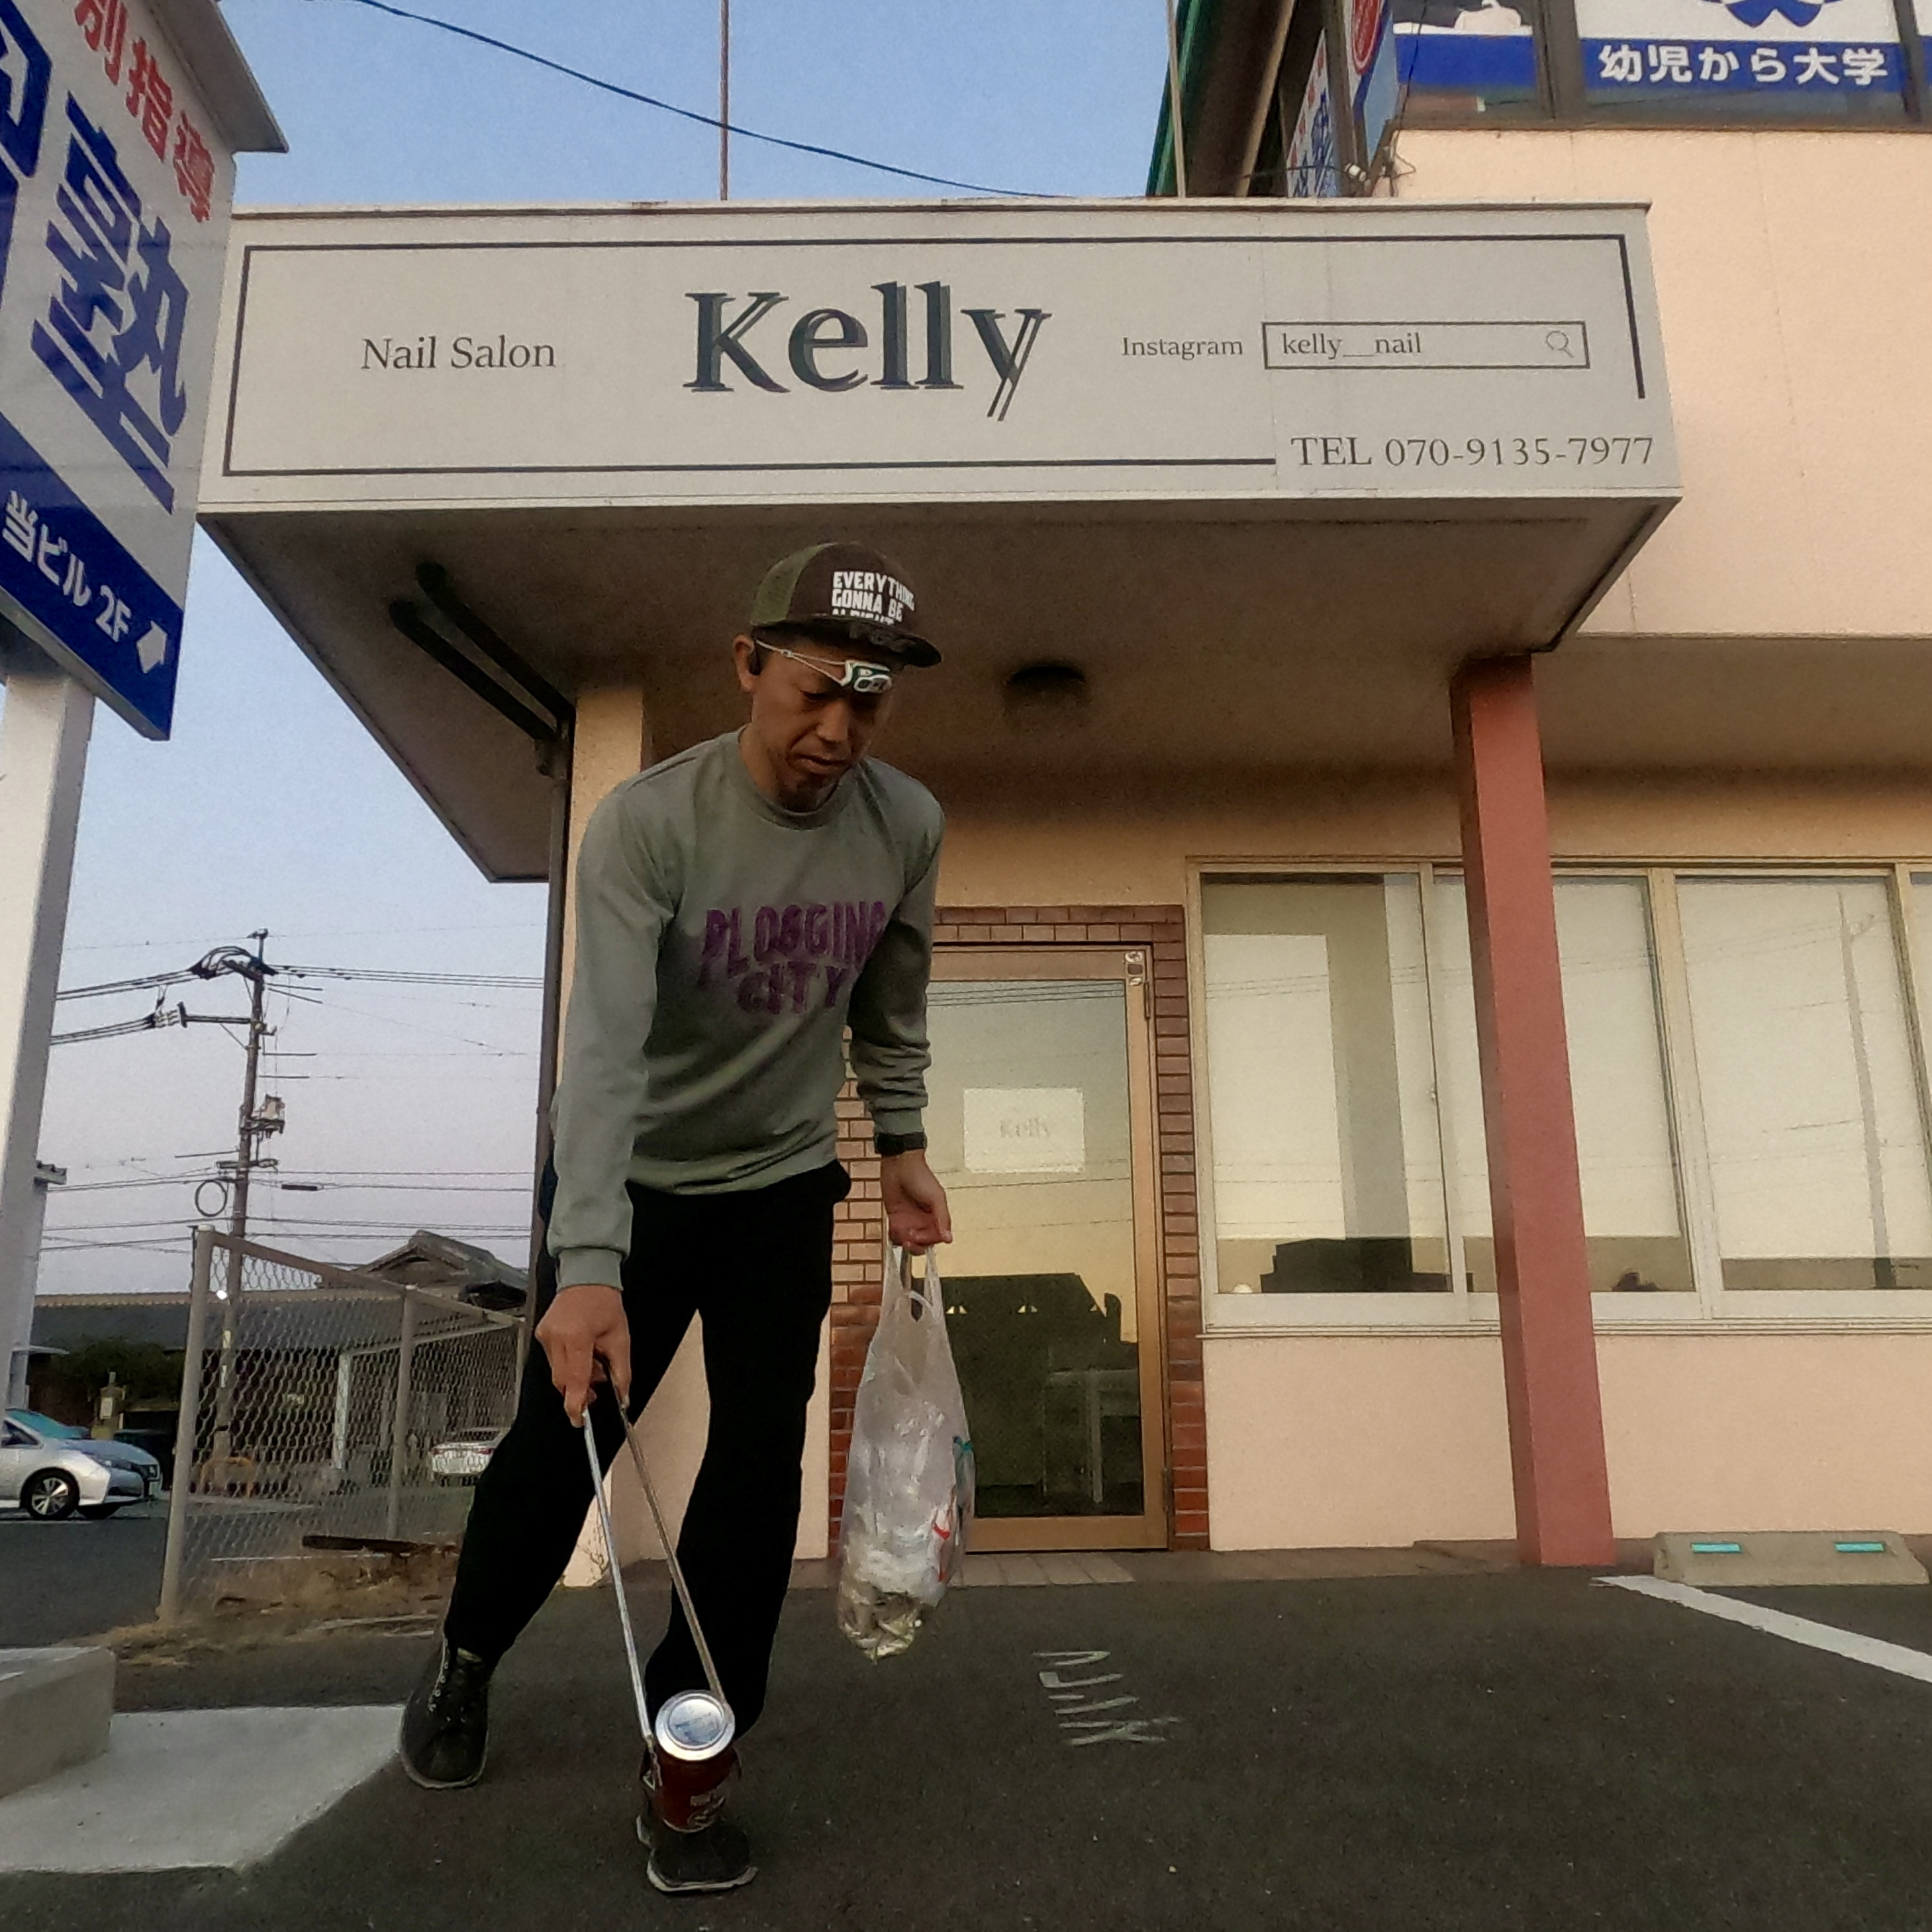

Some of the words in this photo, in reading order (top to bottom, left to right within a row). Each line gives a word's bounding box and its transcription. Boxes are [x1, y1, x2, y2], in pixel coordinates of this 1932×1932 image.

[1599, 44, 1888, 85] 幼児から大学
[362, 336, 436, 369] Nail
[451, 334, 555, 369] Salon
[683, 281, 1052, 422] Kelly
[1122, 336, 1243, 360] Instagram
[1291, 437, 1372, 465] TEL
[1384, 436, 1653, 466] 070-9135-7977
[832, 588, 883, 614] GONNA
[888, 598, 904, 622] BE
[736, 959, 847, 1015] CITY
